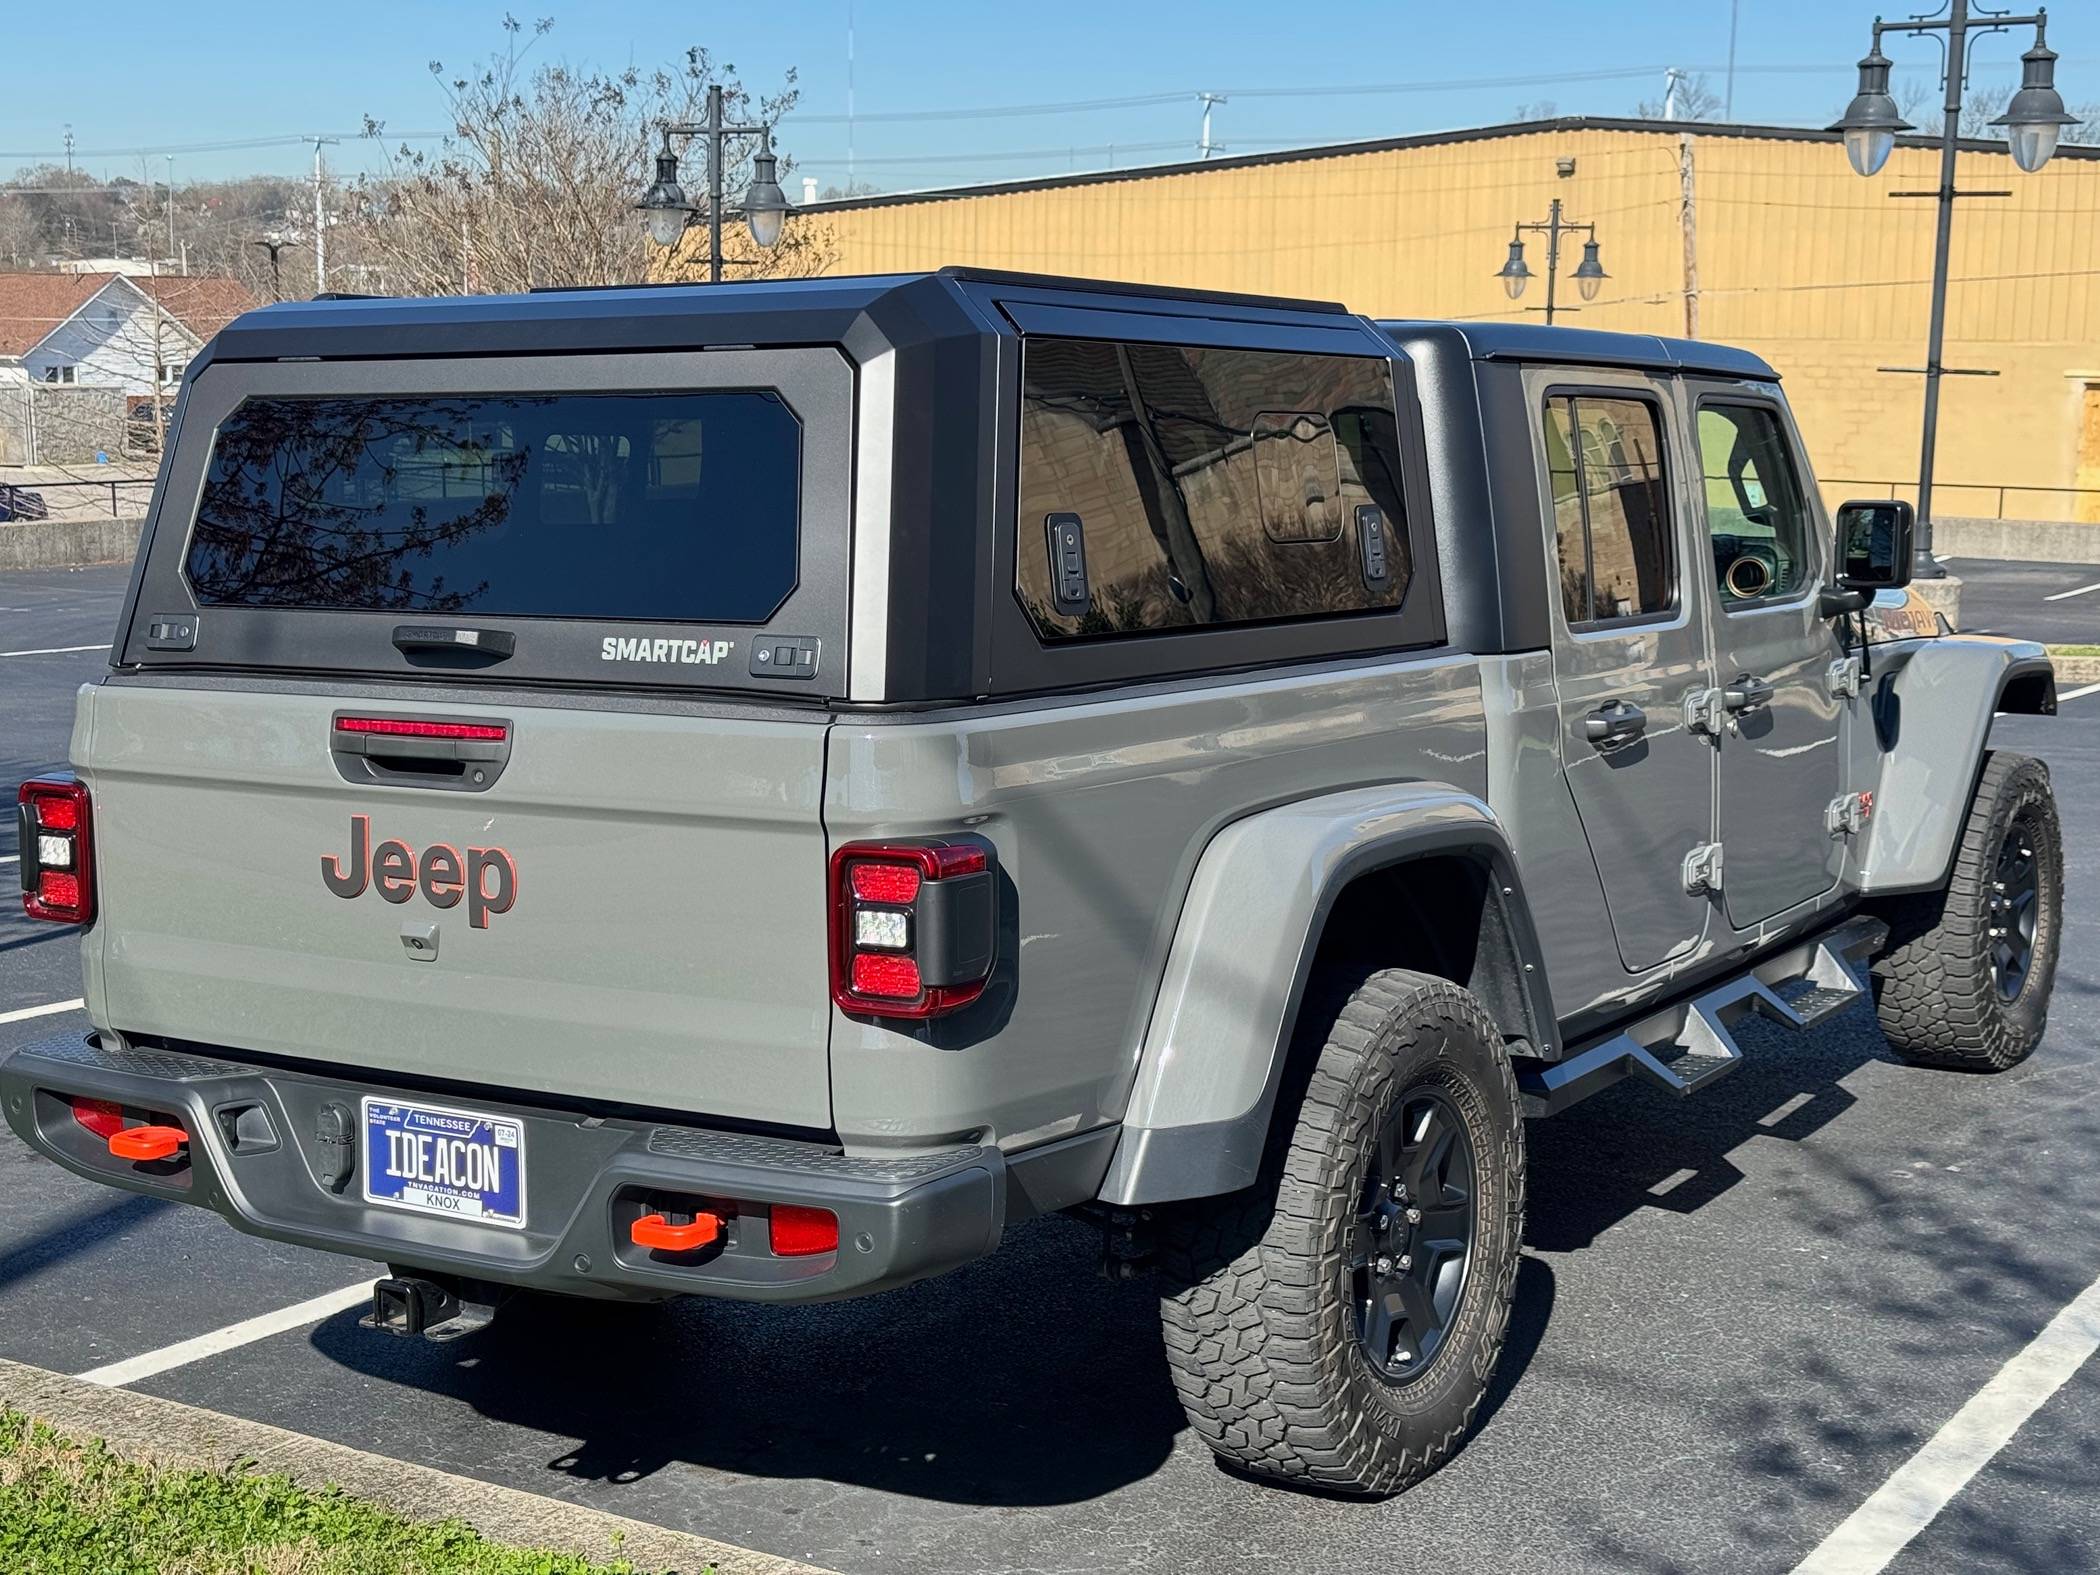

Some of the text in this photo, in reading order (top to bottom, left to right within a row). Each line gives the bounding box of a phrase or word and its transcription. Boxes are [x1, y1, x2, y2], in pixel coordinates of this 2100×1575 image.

[601, 637, 729, 665] SMARTCAP
[321, 814, 518, 929] Jeep
[414, 1113, 472, 1132] TENNESSEE
[408, 1182, 480, 1199] TNVACATION.COM
[426, 1193, 461, 1211] KNOX
